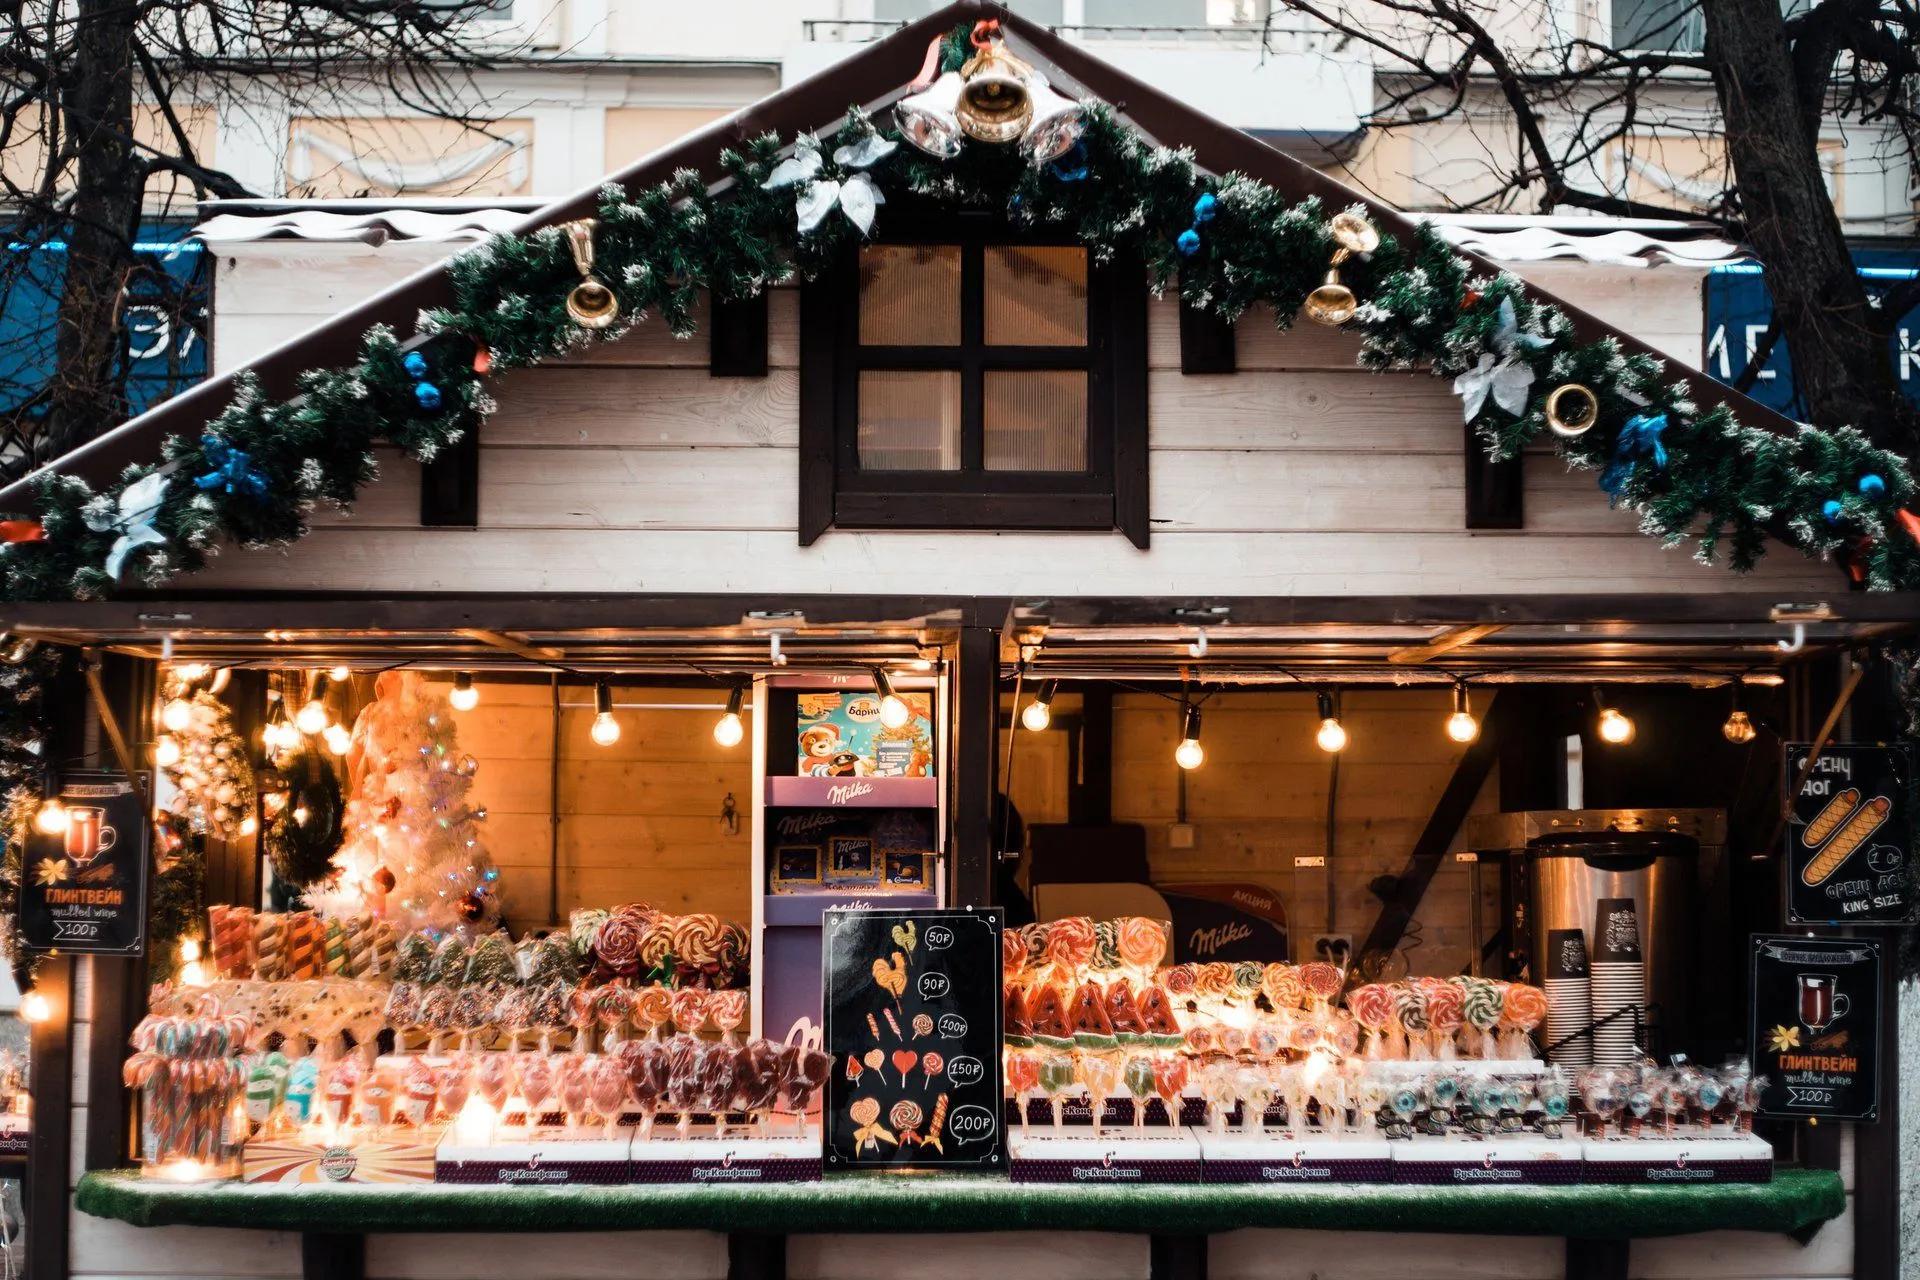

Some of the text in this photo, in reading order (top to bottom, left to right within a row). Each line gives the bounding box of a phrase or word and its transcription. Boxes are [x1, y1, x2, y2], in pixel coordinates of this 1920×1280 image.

[849, 705, 881, 717] Барни
[827, 781, 874, 804] Milka
[836, 839, 870, 853] Milka
[46, 887, 122, 904] ГЛИНТВЕЙН
[1842, 893, 1903, 914] KING SIZE
[51, 904, 118, 919] mulled wine
[1190, 921, 1253, 956] Milka
[1780, 1054, 1857, 1072] ГЛИНТВЕЙН
[1785, 1070, 1852, 1086] mulled wine
[498, 1168, 568, 1181] РусКонфета
[693, 1167, 761, 1180] РусКонфета
[1073, 1168, 1141, 1180] РусКонфета
[1262, 1166, 1331, 1180] РусКонфета
[1453, 1167, 1522, 1180] РусКонфета
[1646, 1167, 1715, 1180] РусКонфета
